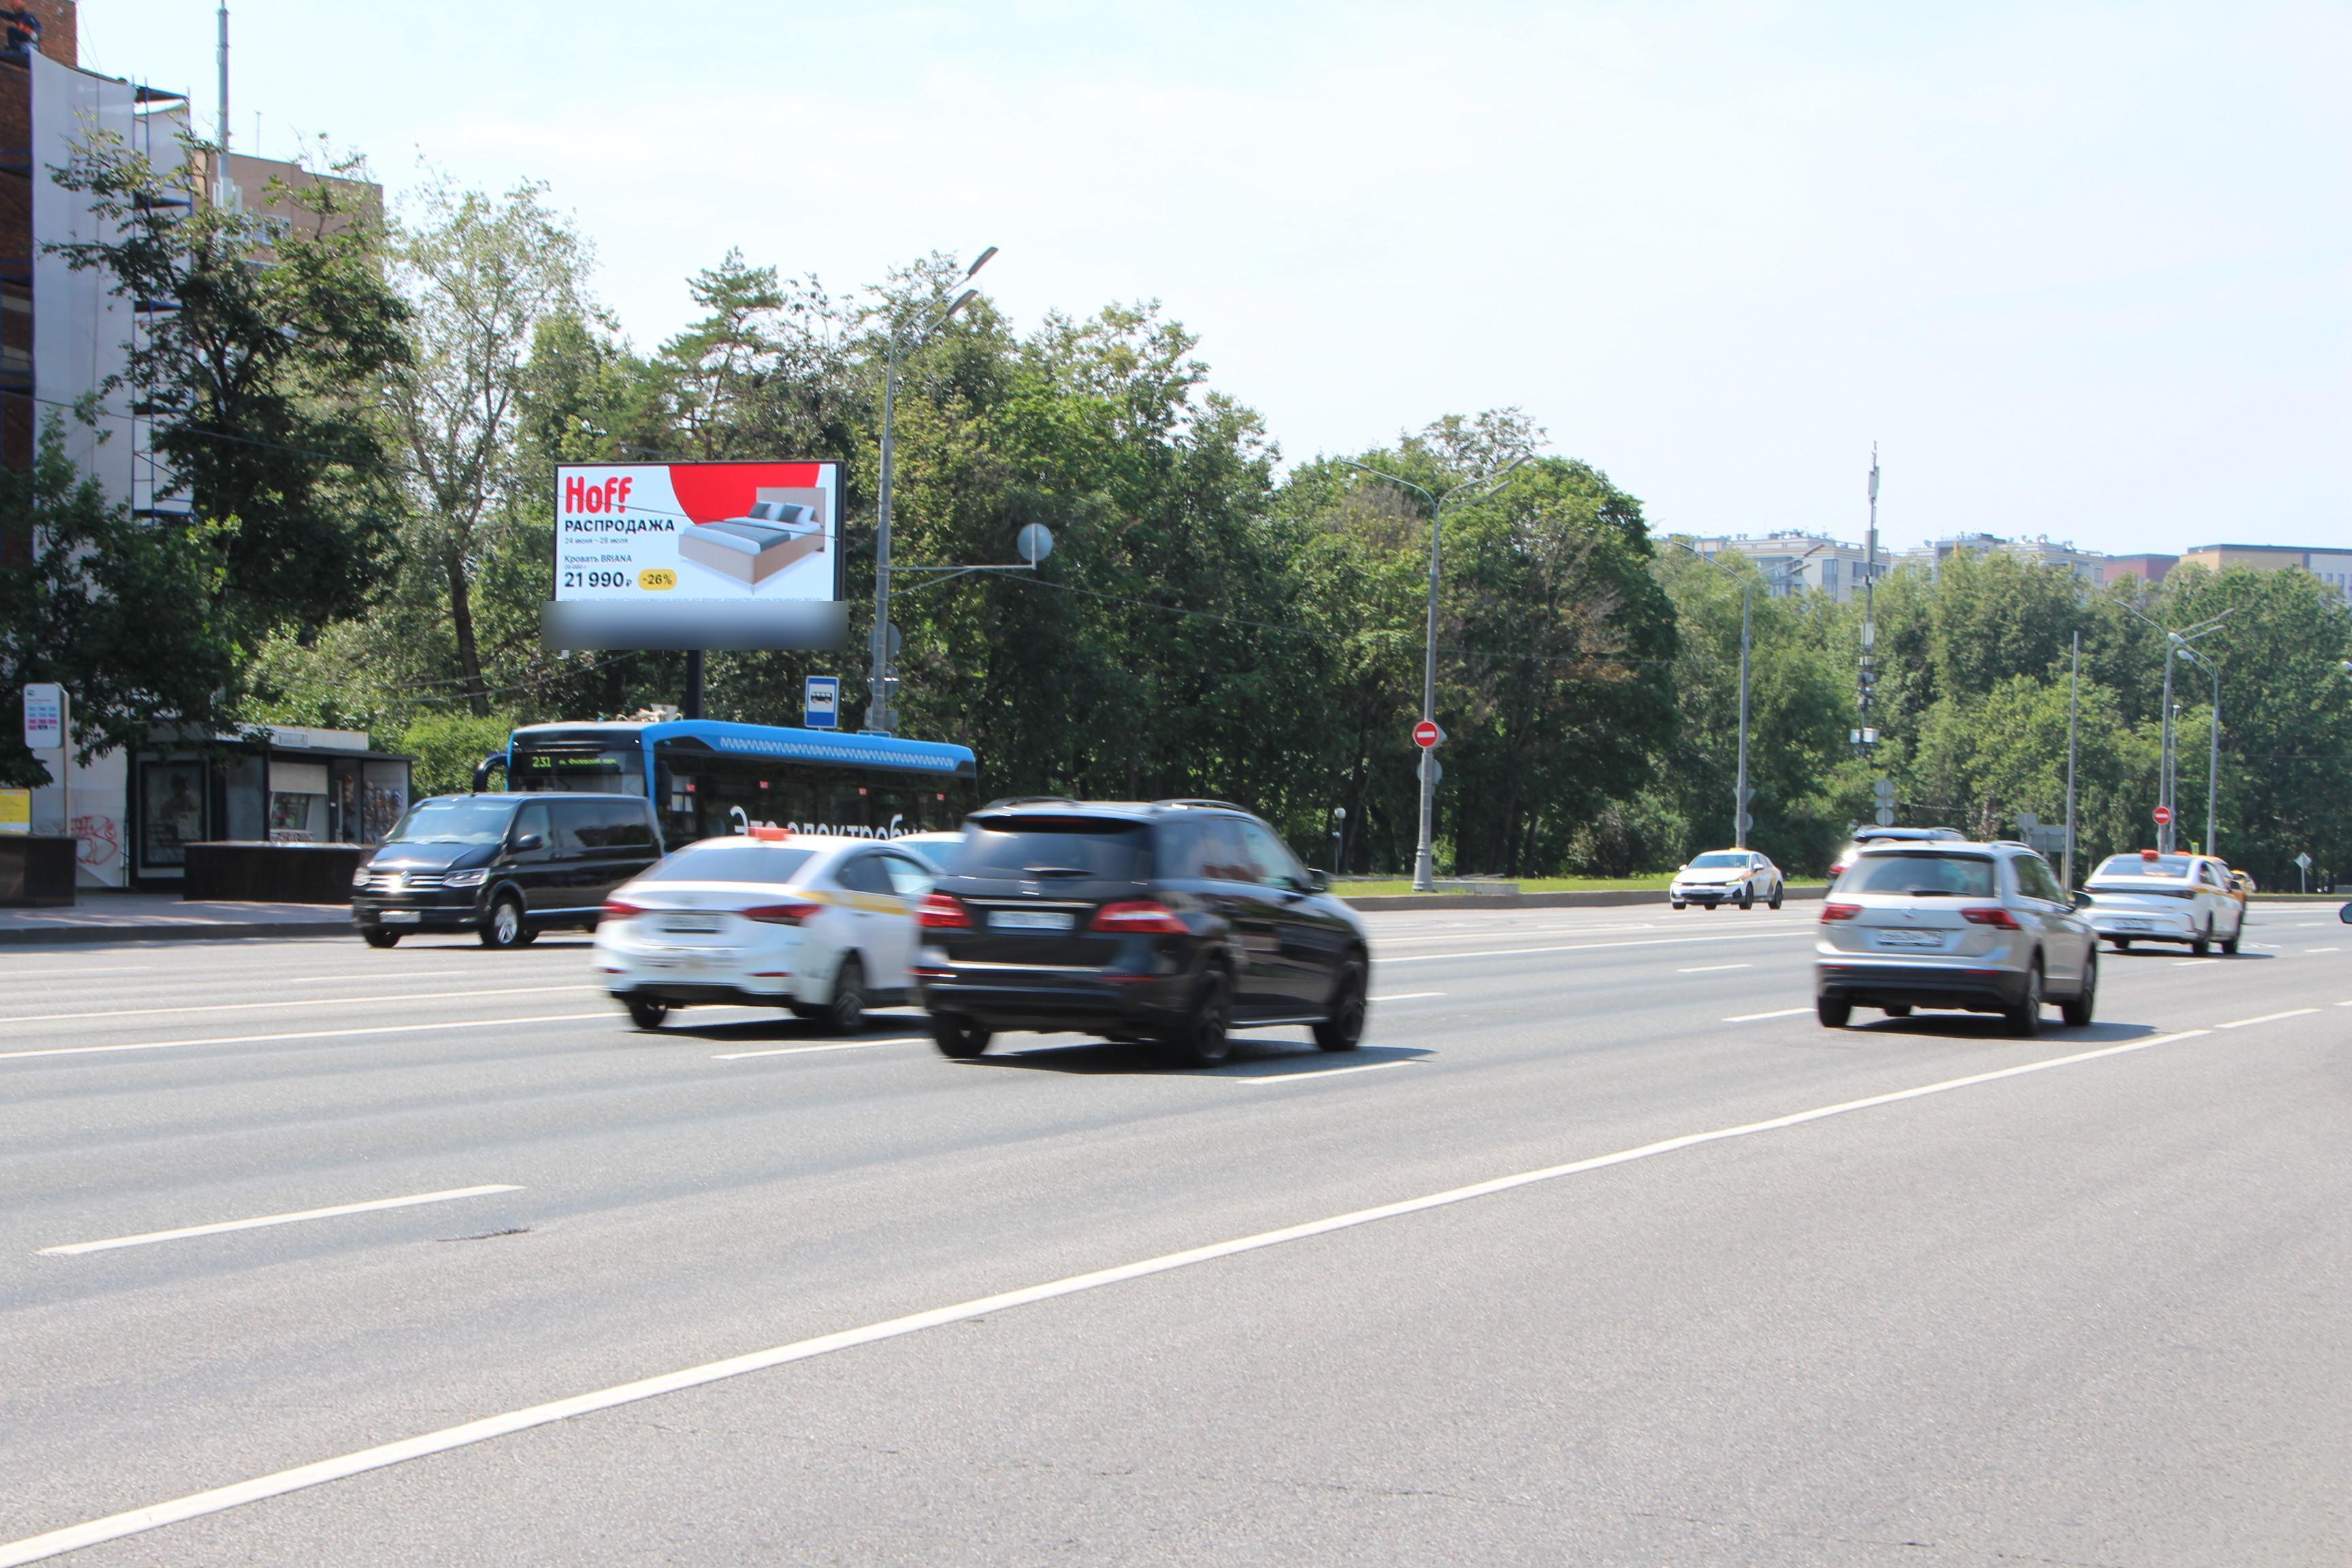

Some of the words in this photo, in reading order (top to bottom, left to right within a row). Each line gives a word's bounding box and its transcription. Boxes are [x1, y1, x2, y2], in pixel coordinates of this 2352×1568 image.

[566, 476, 632, 513] Hoff
[565, 519, 674, 534] РАСПРОДАЖА
[564, 555, 599, 564] Кровать
[600, 554, 632, 563] BRIANA
[564, 572, 583, 587] 21
[642, 574, 672, 585] -26%
[532, 756, 551, 768] 231
